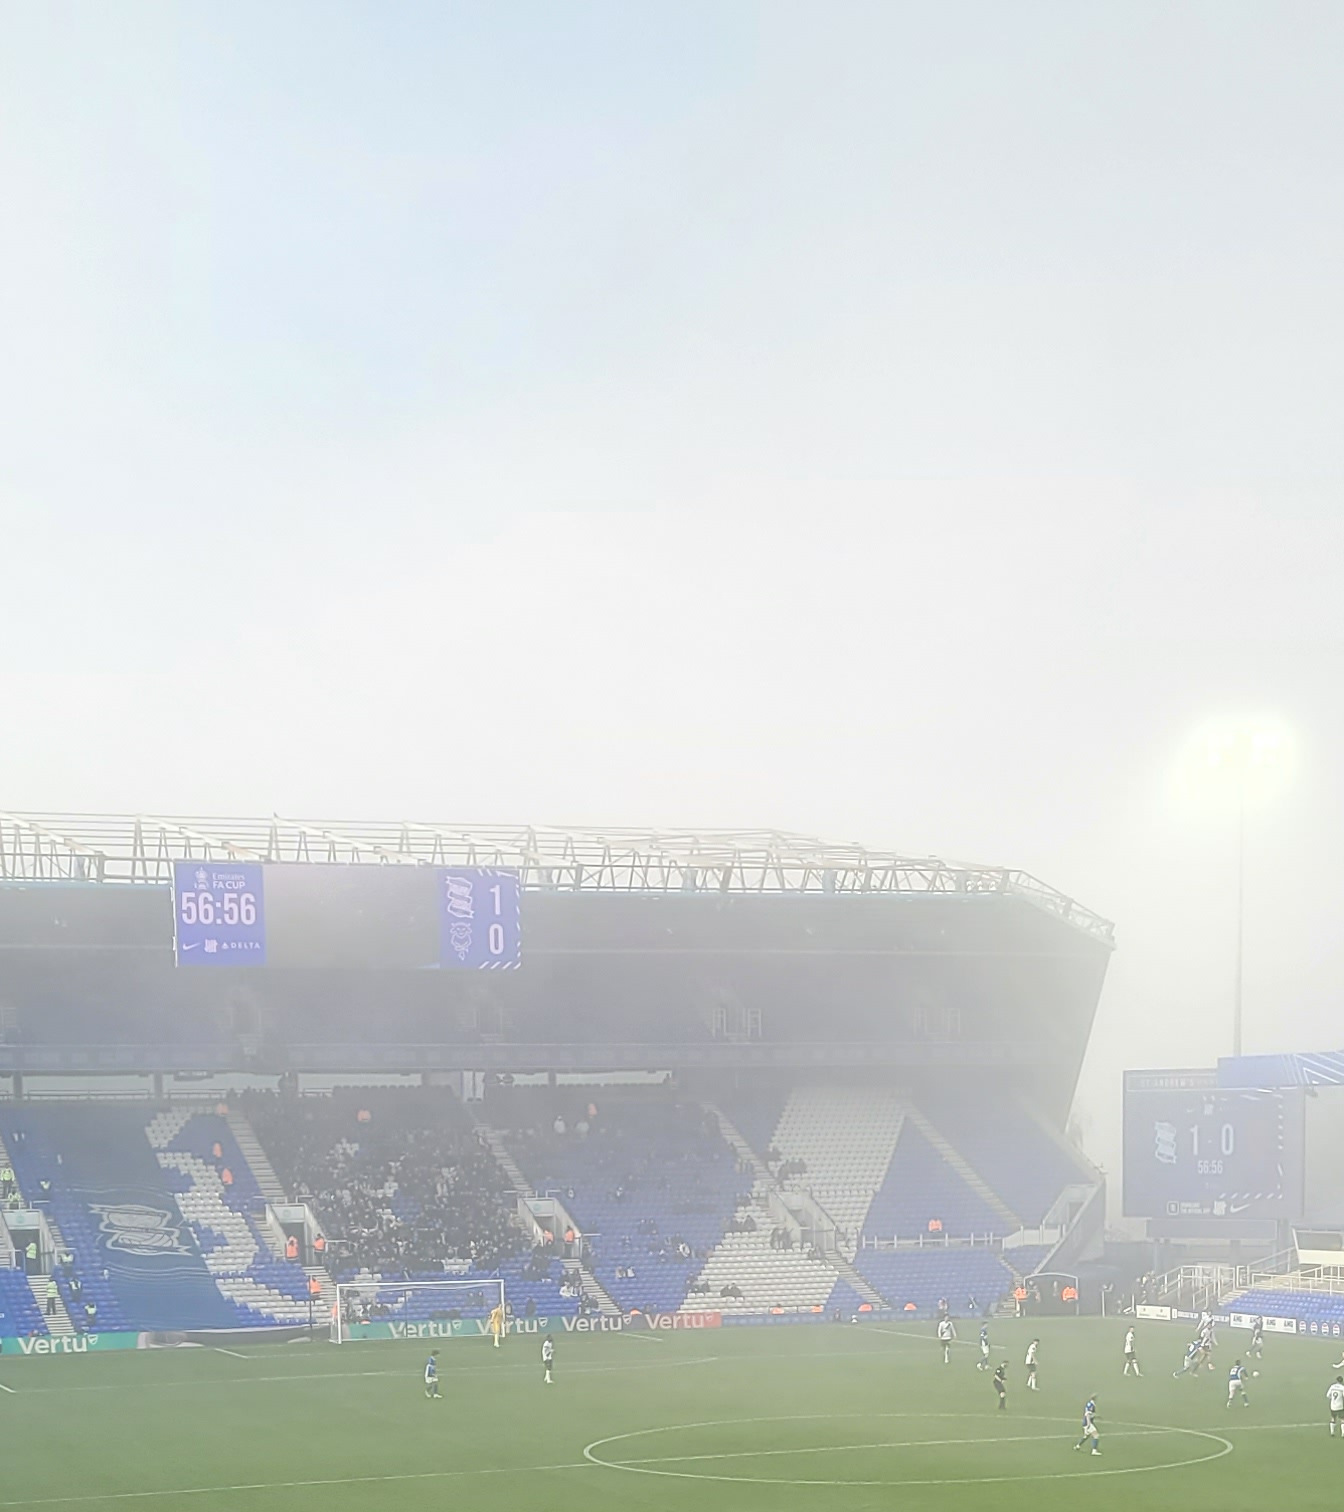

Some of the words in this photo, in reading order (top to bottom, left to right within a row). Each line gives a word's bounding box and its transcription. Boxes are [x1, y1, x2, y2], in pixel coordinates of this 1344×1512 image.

[213, 881, 224, 889] FA
[225, 881, 245, 889] CUP
[181, 891, 256, 925] 56:56
[489, 885, 500, 915] 1
[489, 923, 504, 955] 0
[1189, 1124, 1199, 1156] 1
[1221, 1123, 1234, 1156] 0
[1197, 1160, 1224, 1174] 56:56
[389, 1320, 453, 1338] Vertu
[561, 1315, 622, 1331] Vertu
[645, 1313, 706, 1330] Vertu
[18, 1335, 88, 1355] Vertu
[1332, 1391, 1339, 1400] 9
